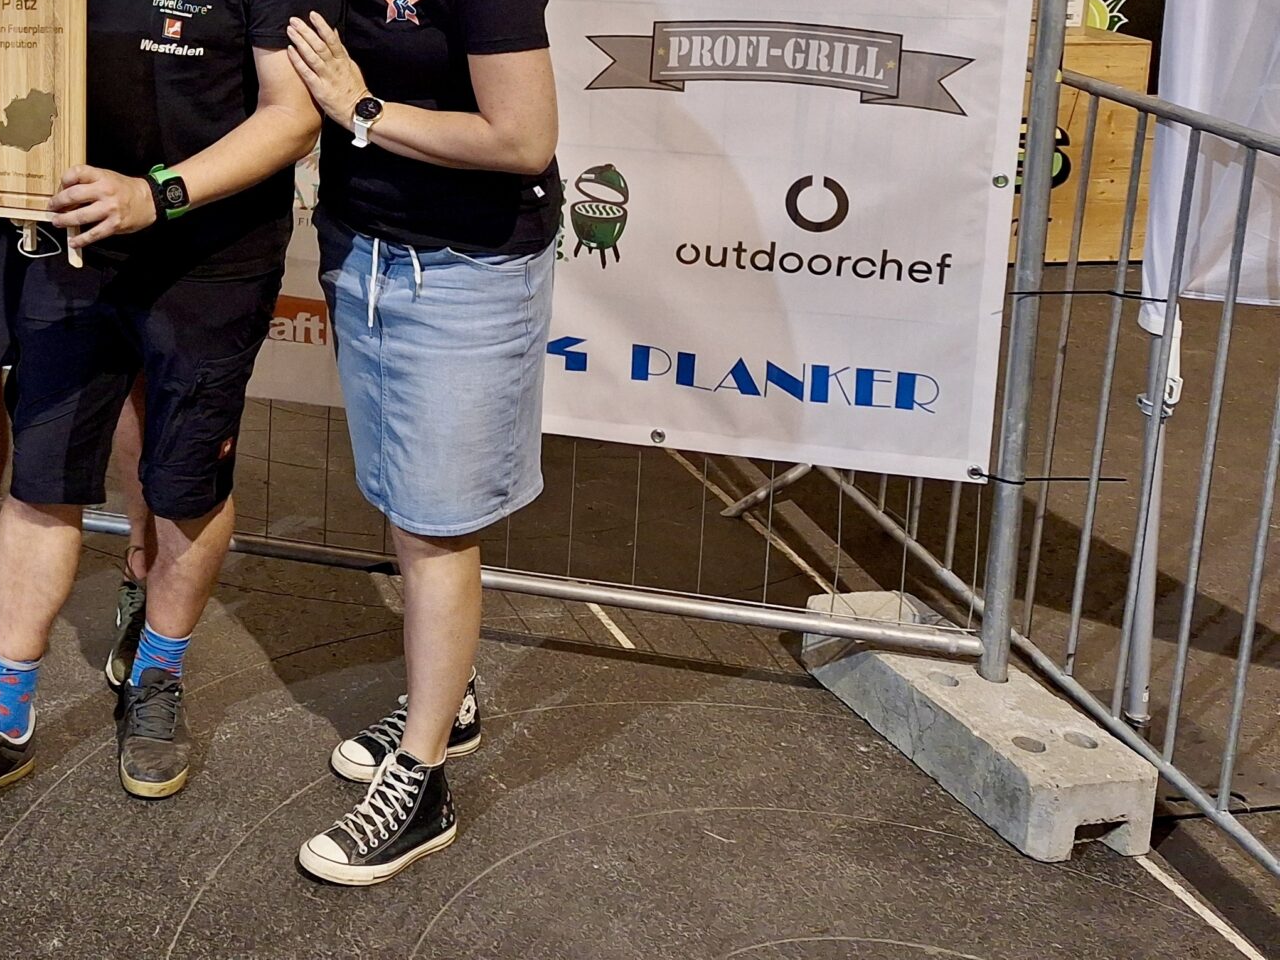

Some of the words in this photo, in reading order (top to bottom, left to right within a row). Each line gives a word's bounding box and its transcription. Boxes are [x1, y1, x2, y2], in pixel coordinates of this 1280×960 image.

[176, 1, 184, 9] &
[140, 39, 205, 57] Westfalen
[667, 34, 885, 81] PROFI-GRILL
[675, 239, 953, 286] outdoorchef
[631, 343, 940, 414] PLANKER
